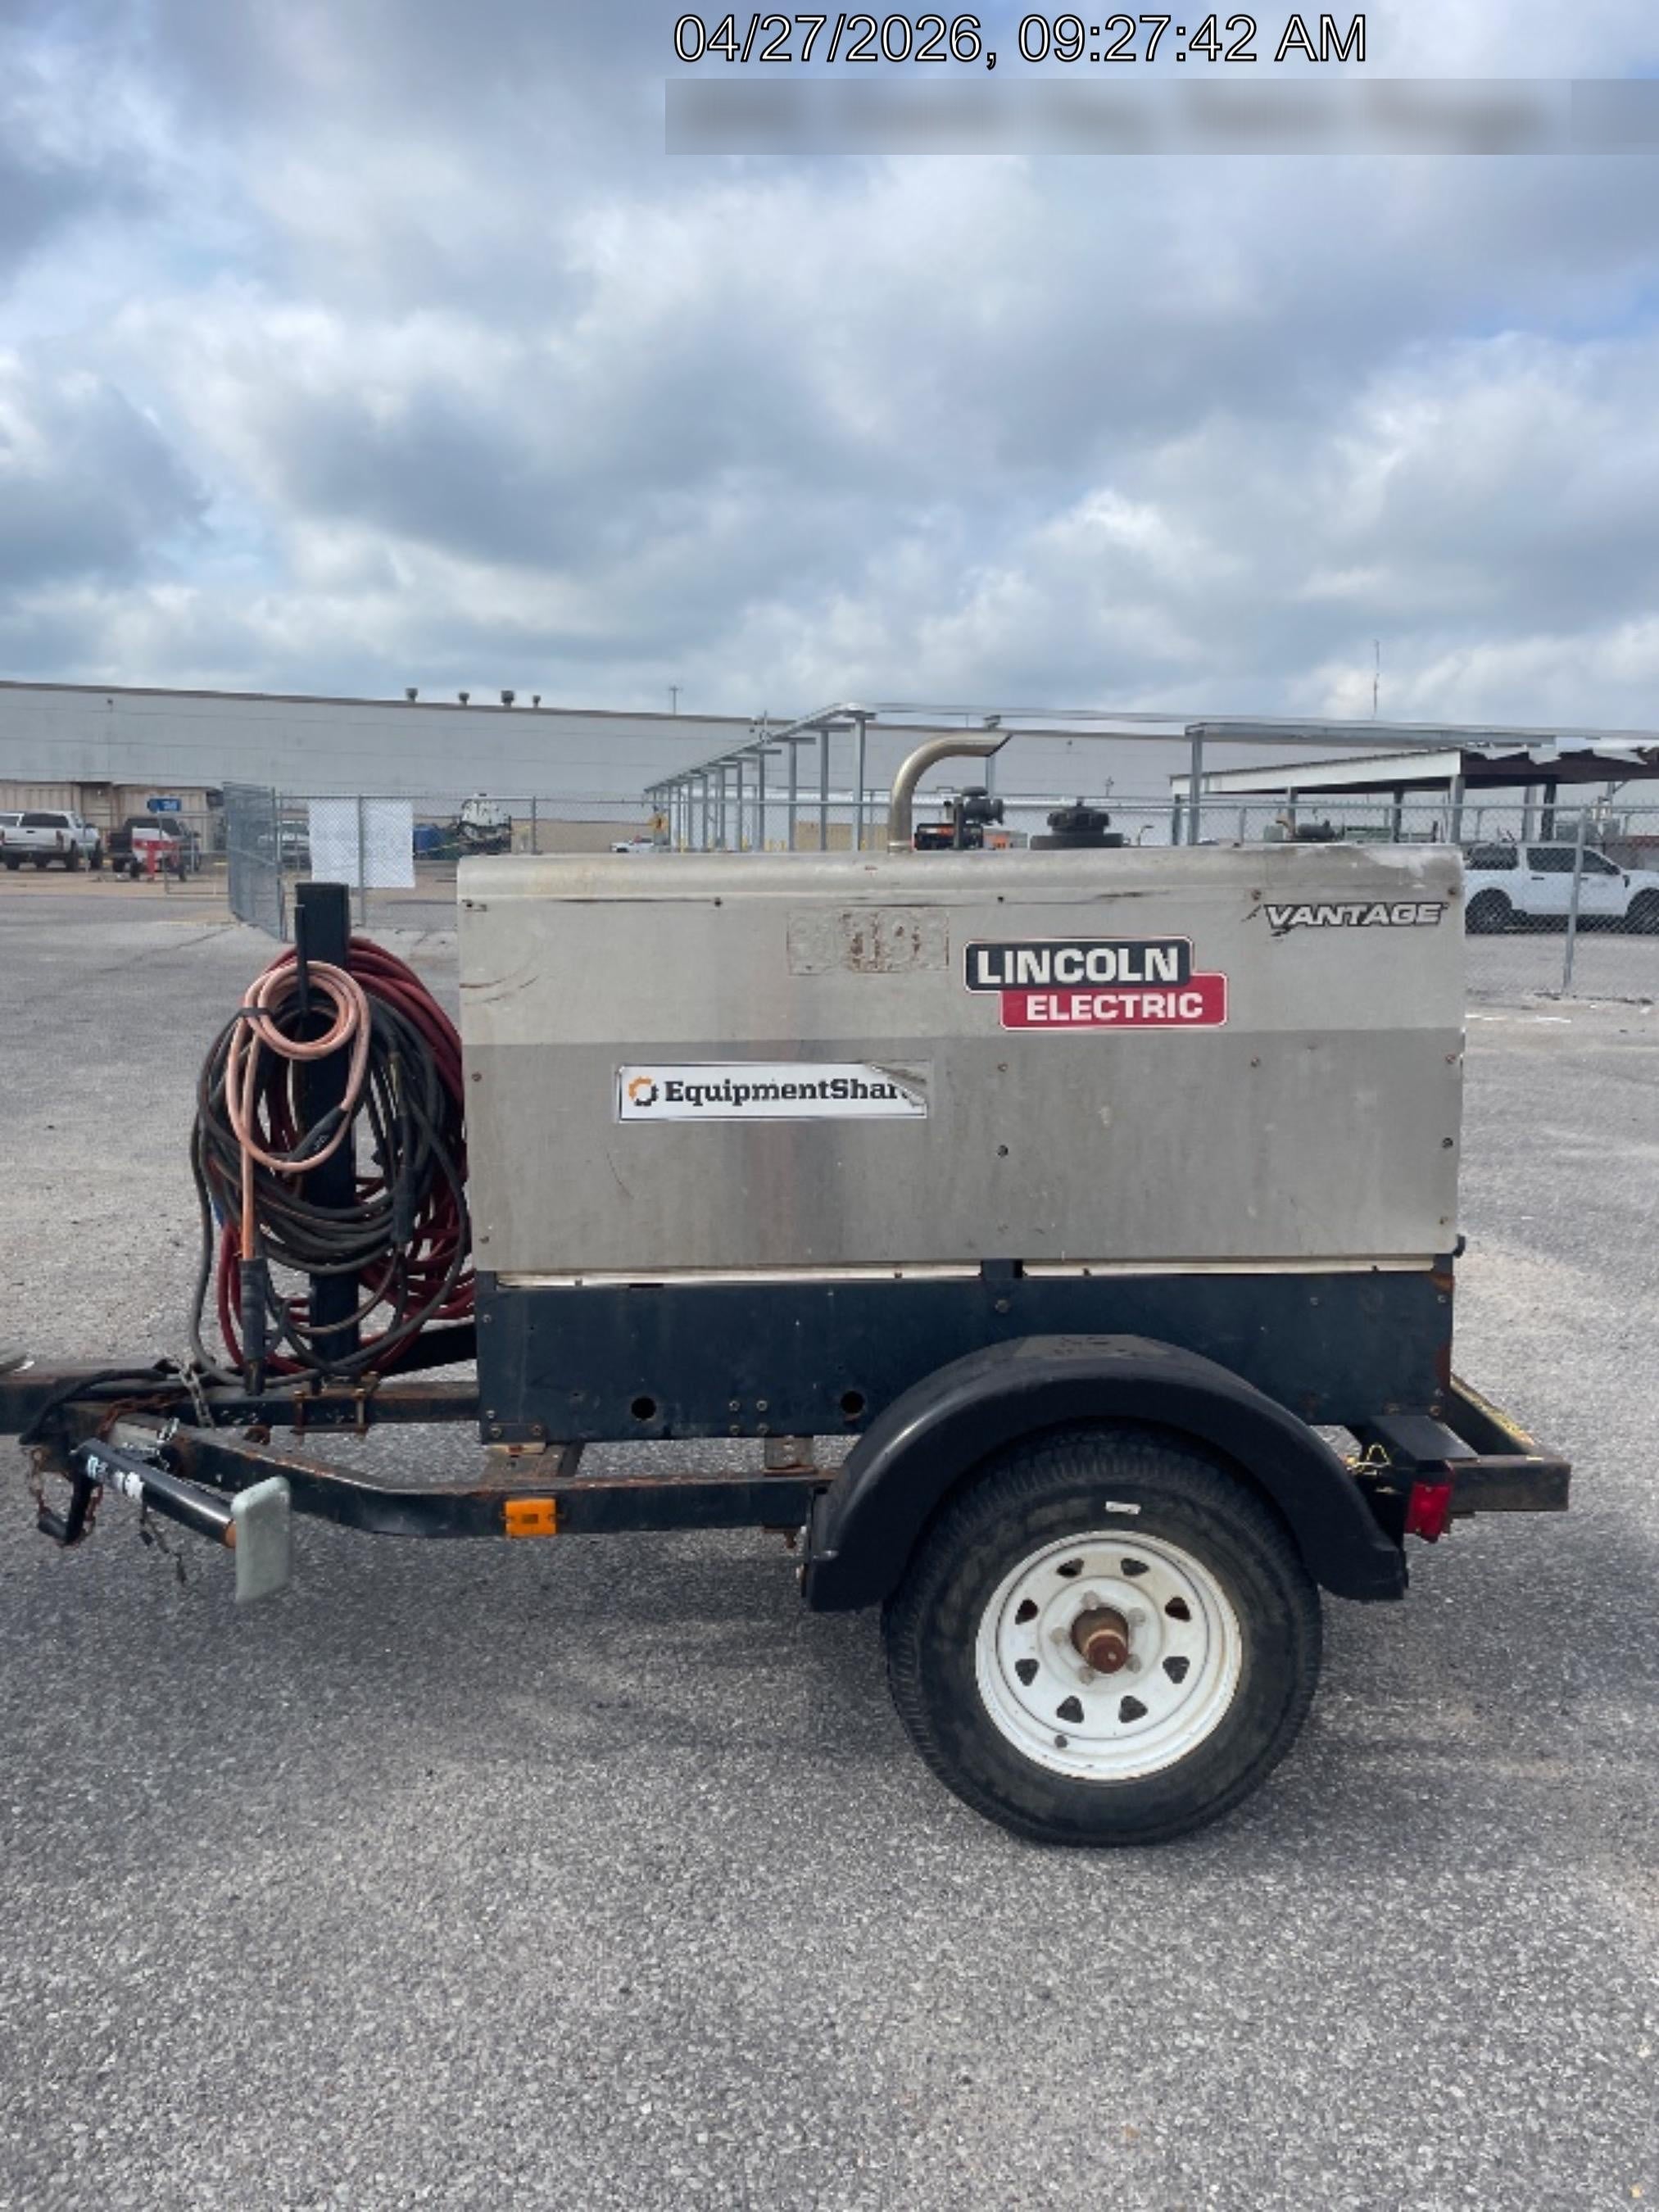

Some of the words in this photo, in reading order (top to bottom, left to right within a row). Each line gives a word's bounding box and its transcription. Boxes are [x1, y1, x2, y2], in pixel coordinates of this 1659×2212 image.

[1264, 902, 1444, 929] VANTAGE
[977, 945, 1178, 984] LINCOLN
[1027, 991, 1203, 1022] ELECTRIC
[664, 1077, 909, 1107] EquipmentShar
